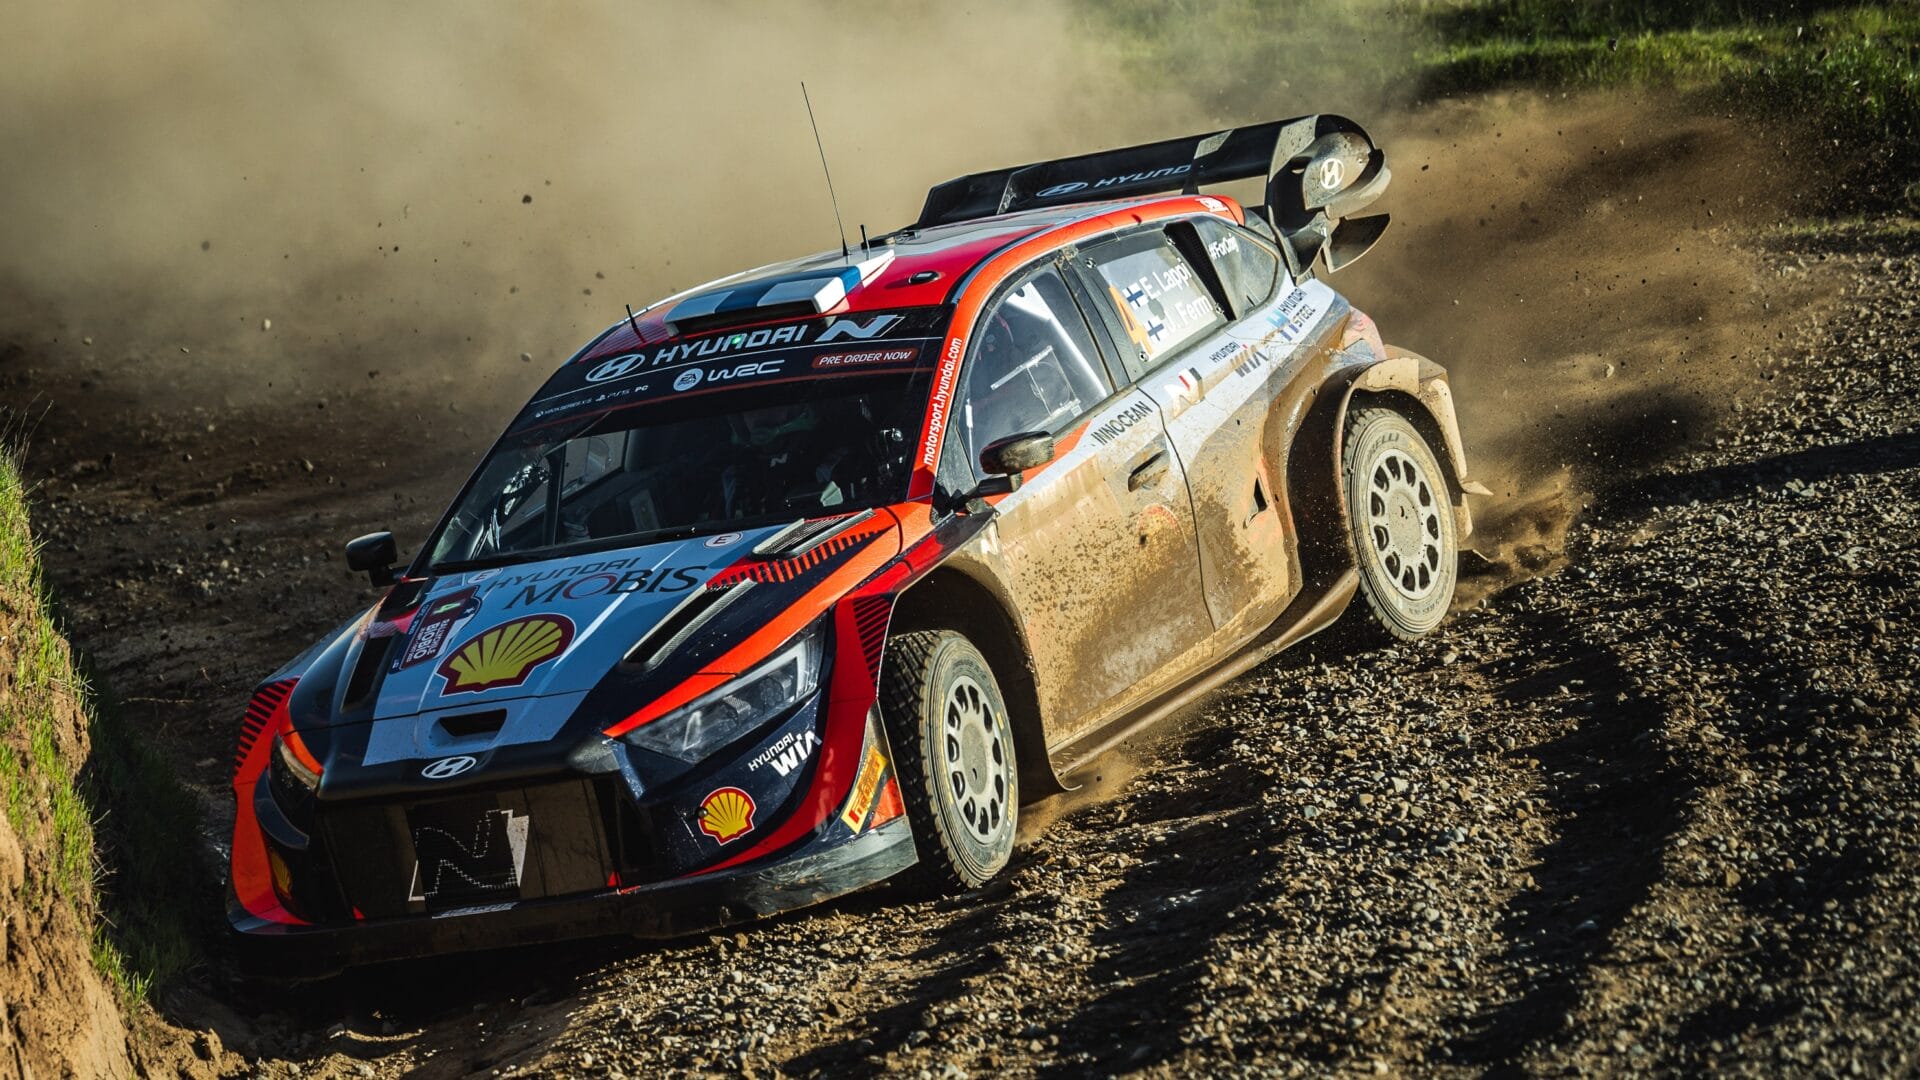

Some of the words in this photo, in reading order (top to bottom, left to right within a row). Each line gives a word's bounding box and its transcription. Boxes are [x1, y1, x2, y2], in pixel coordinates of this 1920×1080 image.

[1093, 164, 1193, 187] HYUND
[1152, 257, 1192, 292] Lappi
[1108, 284, 1153, 355] 4
[1174, 295, 1214, 327] Ferm
[1293, 304, 1316, 328] STEEL
[652, 325, 808, 366] HYUNDAI
[814, 314, 906, 343] N
[1209, 341, 1241, 364] HYUNDAI
[708, 360, 785, 382] WRC
[819, 355, 841, 366] PRE
[843, 352, 881, 363] ORDER
[884, 350, 912, 361] NOW
[634, 385, 649, 393] PC
[923, 337, 962, 466] motorsport.hyundai.com
[1091, 400, 1153, 447] INNOCEAN
[712, 534, 732, 546] E
[485, 557, 641, 592] HYUNDAI
[503, 565, 708, 610] MOBIS
[748, 732, 795, 772] HYUNDAI
[770, 730, 823, 777] WIA
